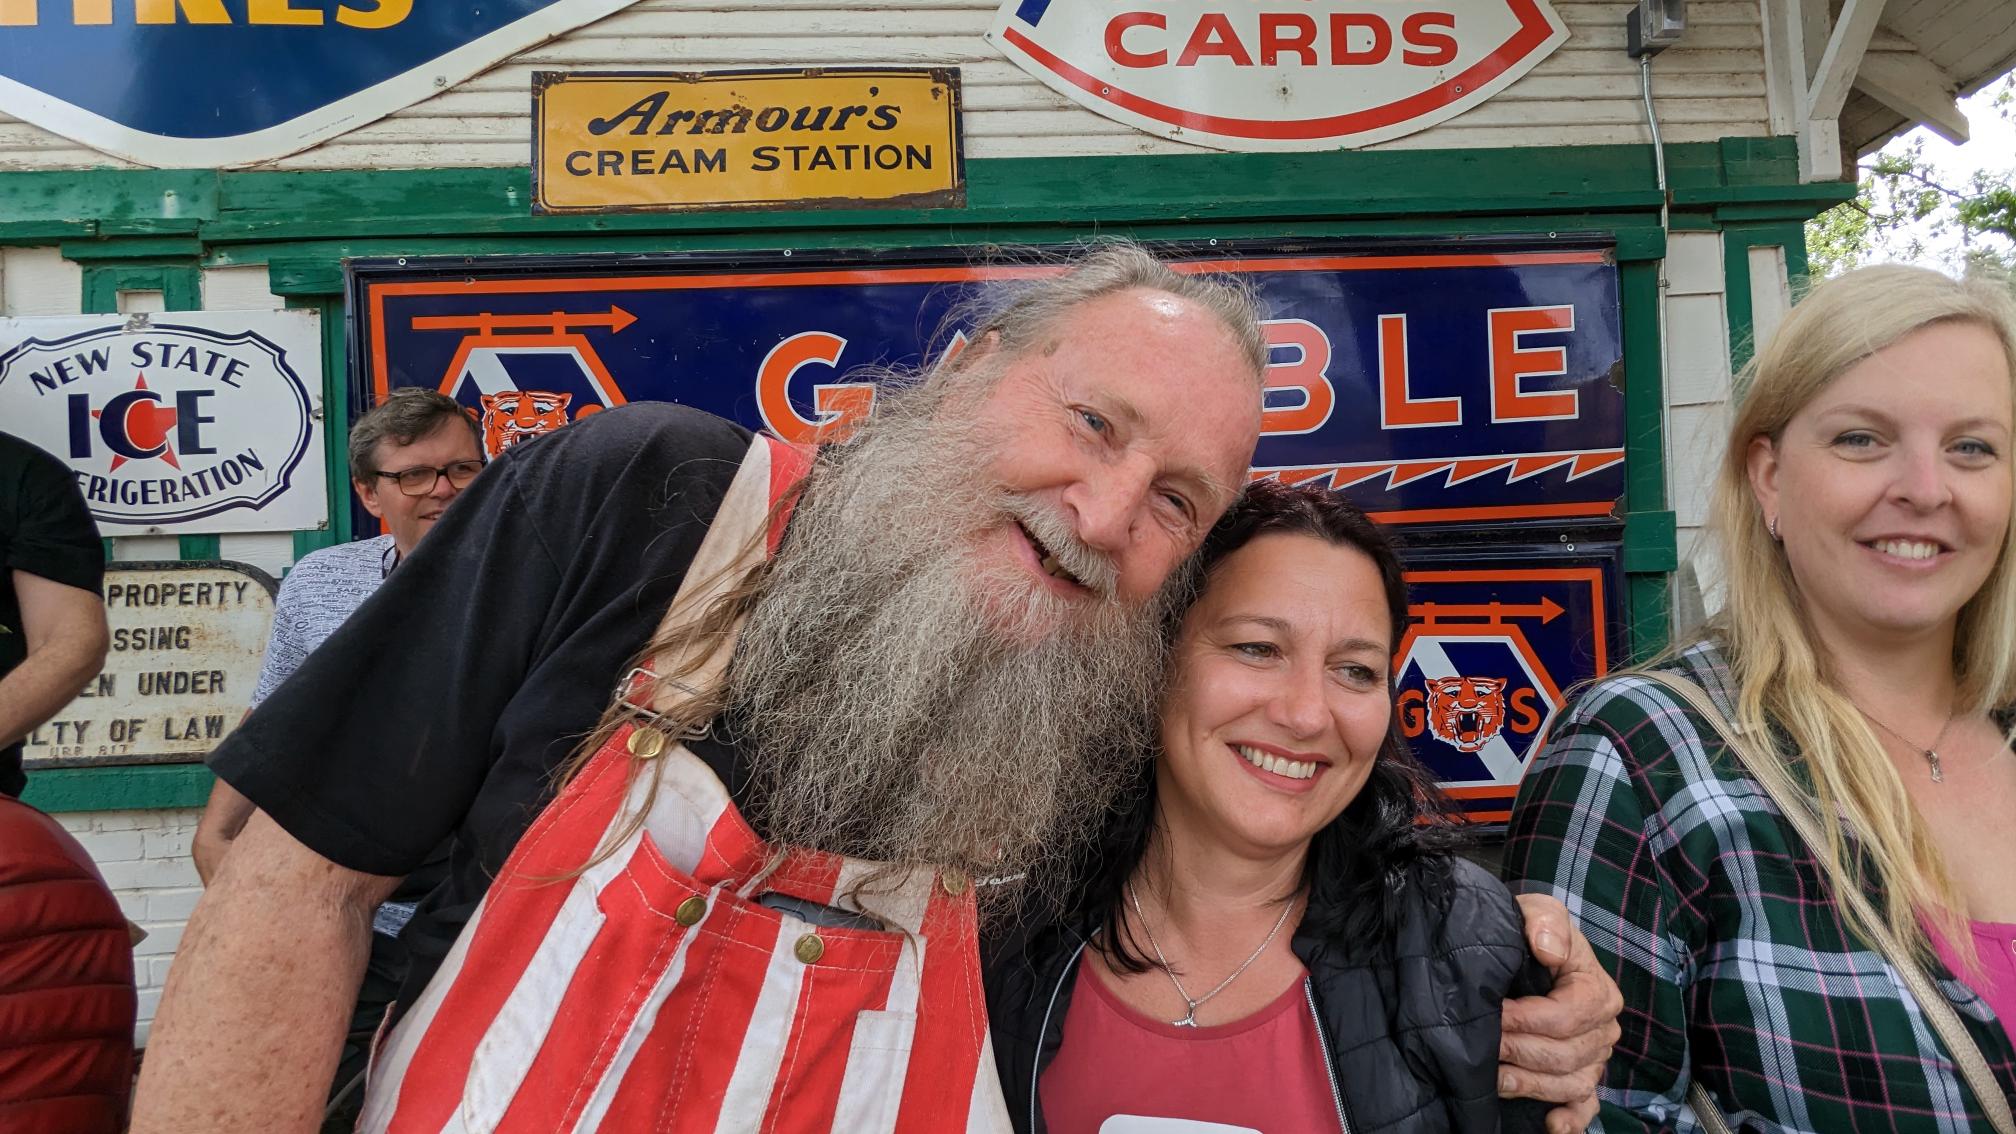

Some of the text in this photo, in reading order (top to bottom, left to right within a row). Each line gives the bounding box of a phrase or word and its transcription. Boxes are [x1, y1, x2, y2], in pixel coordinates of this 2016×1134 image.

[1103, 12, 1459, 69] CARDS
[587, 86, 902, 136] Armour's
[564, 144, 933, 177] CREAM STATION
[29, 341, 250, 396] NEW STATE
[67, 389, 218, 460] ICE
[107, 581, 249, 607] PROPERTY
[113, 626, 190, 652] SSING
[137, 670, 227, 696] UNDER
[109, 718, 148, 743] OF
[164, 714, 225, 740] LAW
